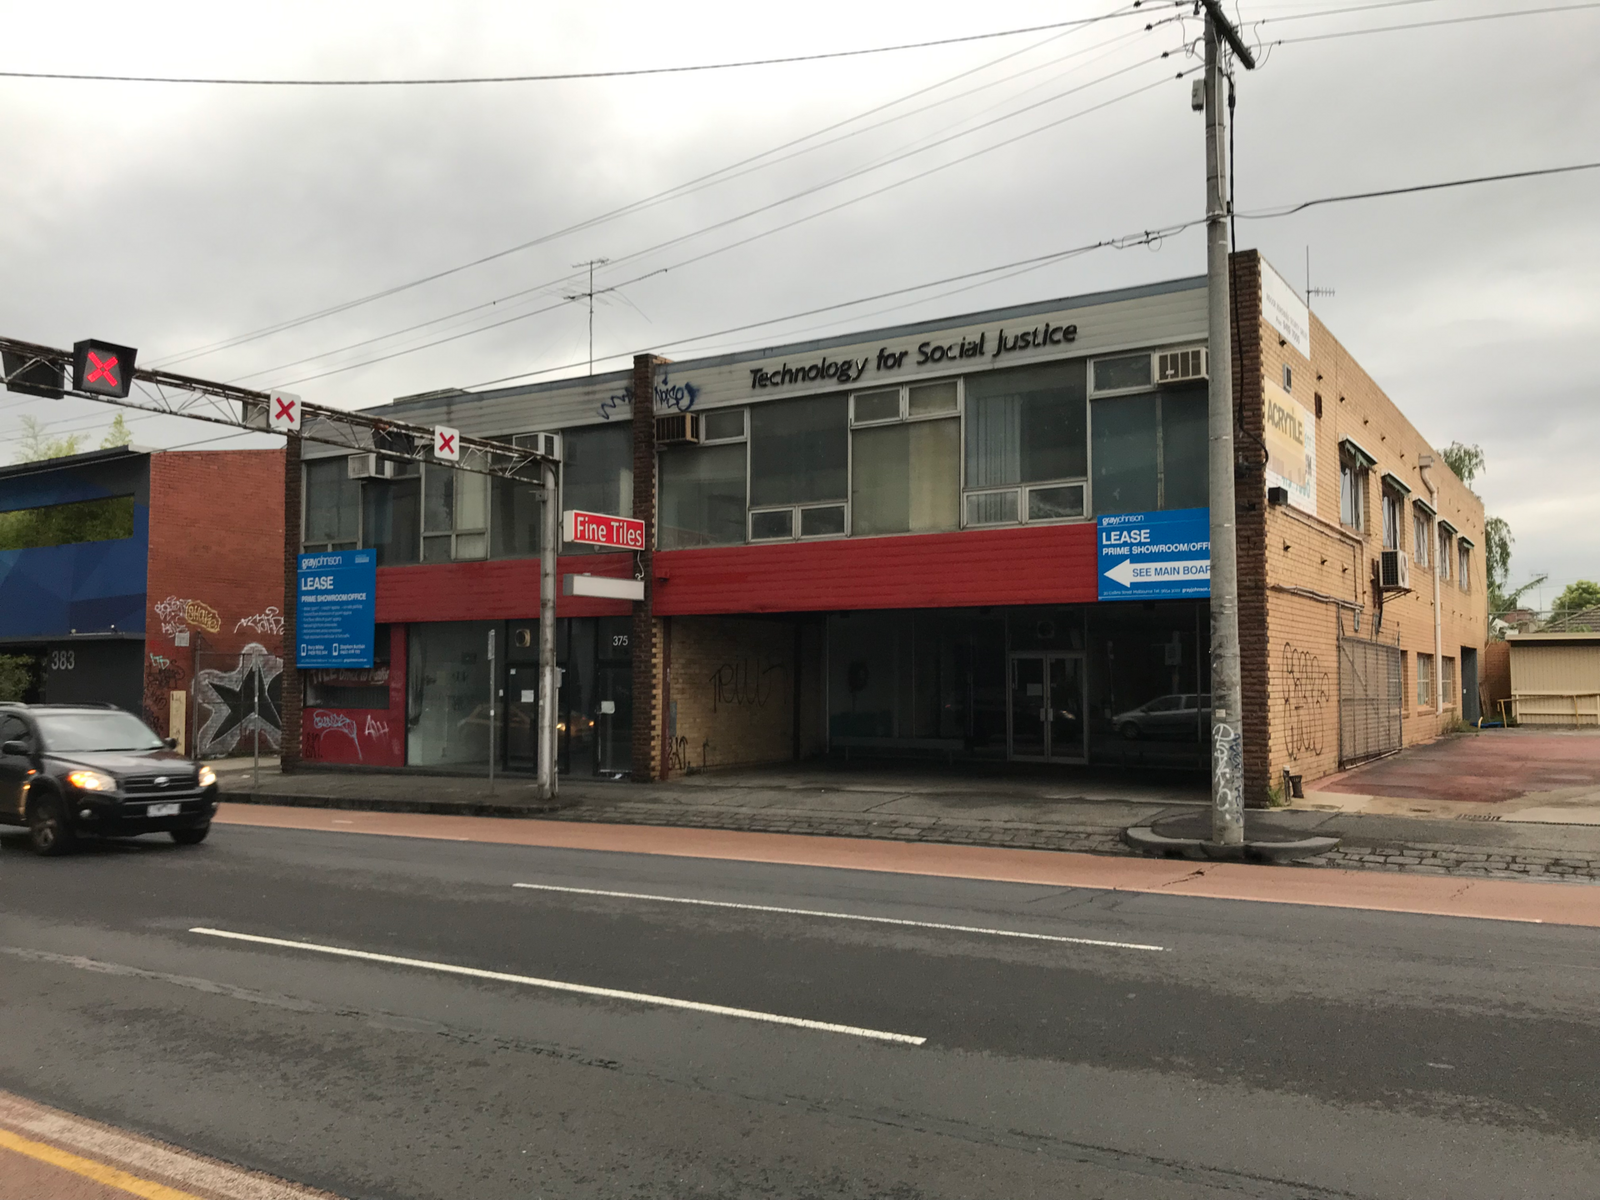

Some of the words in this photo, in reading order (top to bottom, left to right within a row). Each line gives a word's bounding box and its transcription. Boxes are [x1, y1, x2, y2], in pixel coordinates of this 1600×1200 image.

[750, 356, 868, 389] Technology
[876, 348, 908, 371] for
[916, 332, 985, 364] Social
[992, 322, 1078, 357] Justice
[1267, 399, 1303, 446] ACRYTILE
[1102, 514, 1144, 526] grayjohnson
[577, 516, 607, 541] Fine
[611, 521, 642, 546] Tiles
[1102, 529, 1150, 545] LEASE
[1102, 546, 1130, 556] PRIME
[301, 555, 342, 569] grayjohnson
[1132, 568, 1152, 577] SEE
[1154, 566, 1180, 577] MAIN
[301, 576, 334, 591] LEASE
[301, 595, 316, 603] PRIME
[612, 635, 629, 646] 375
[51, 650, 75, 670] 383
